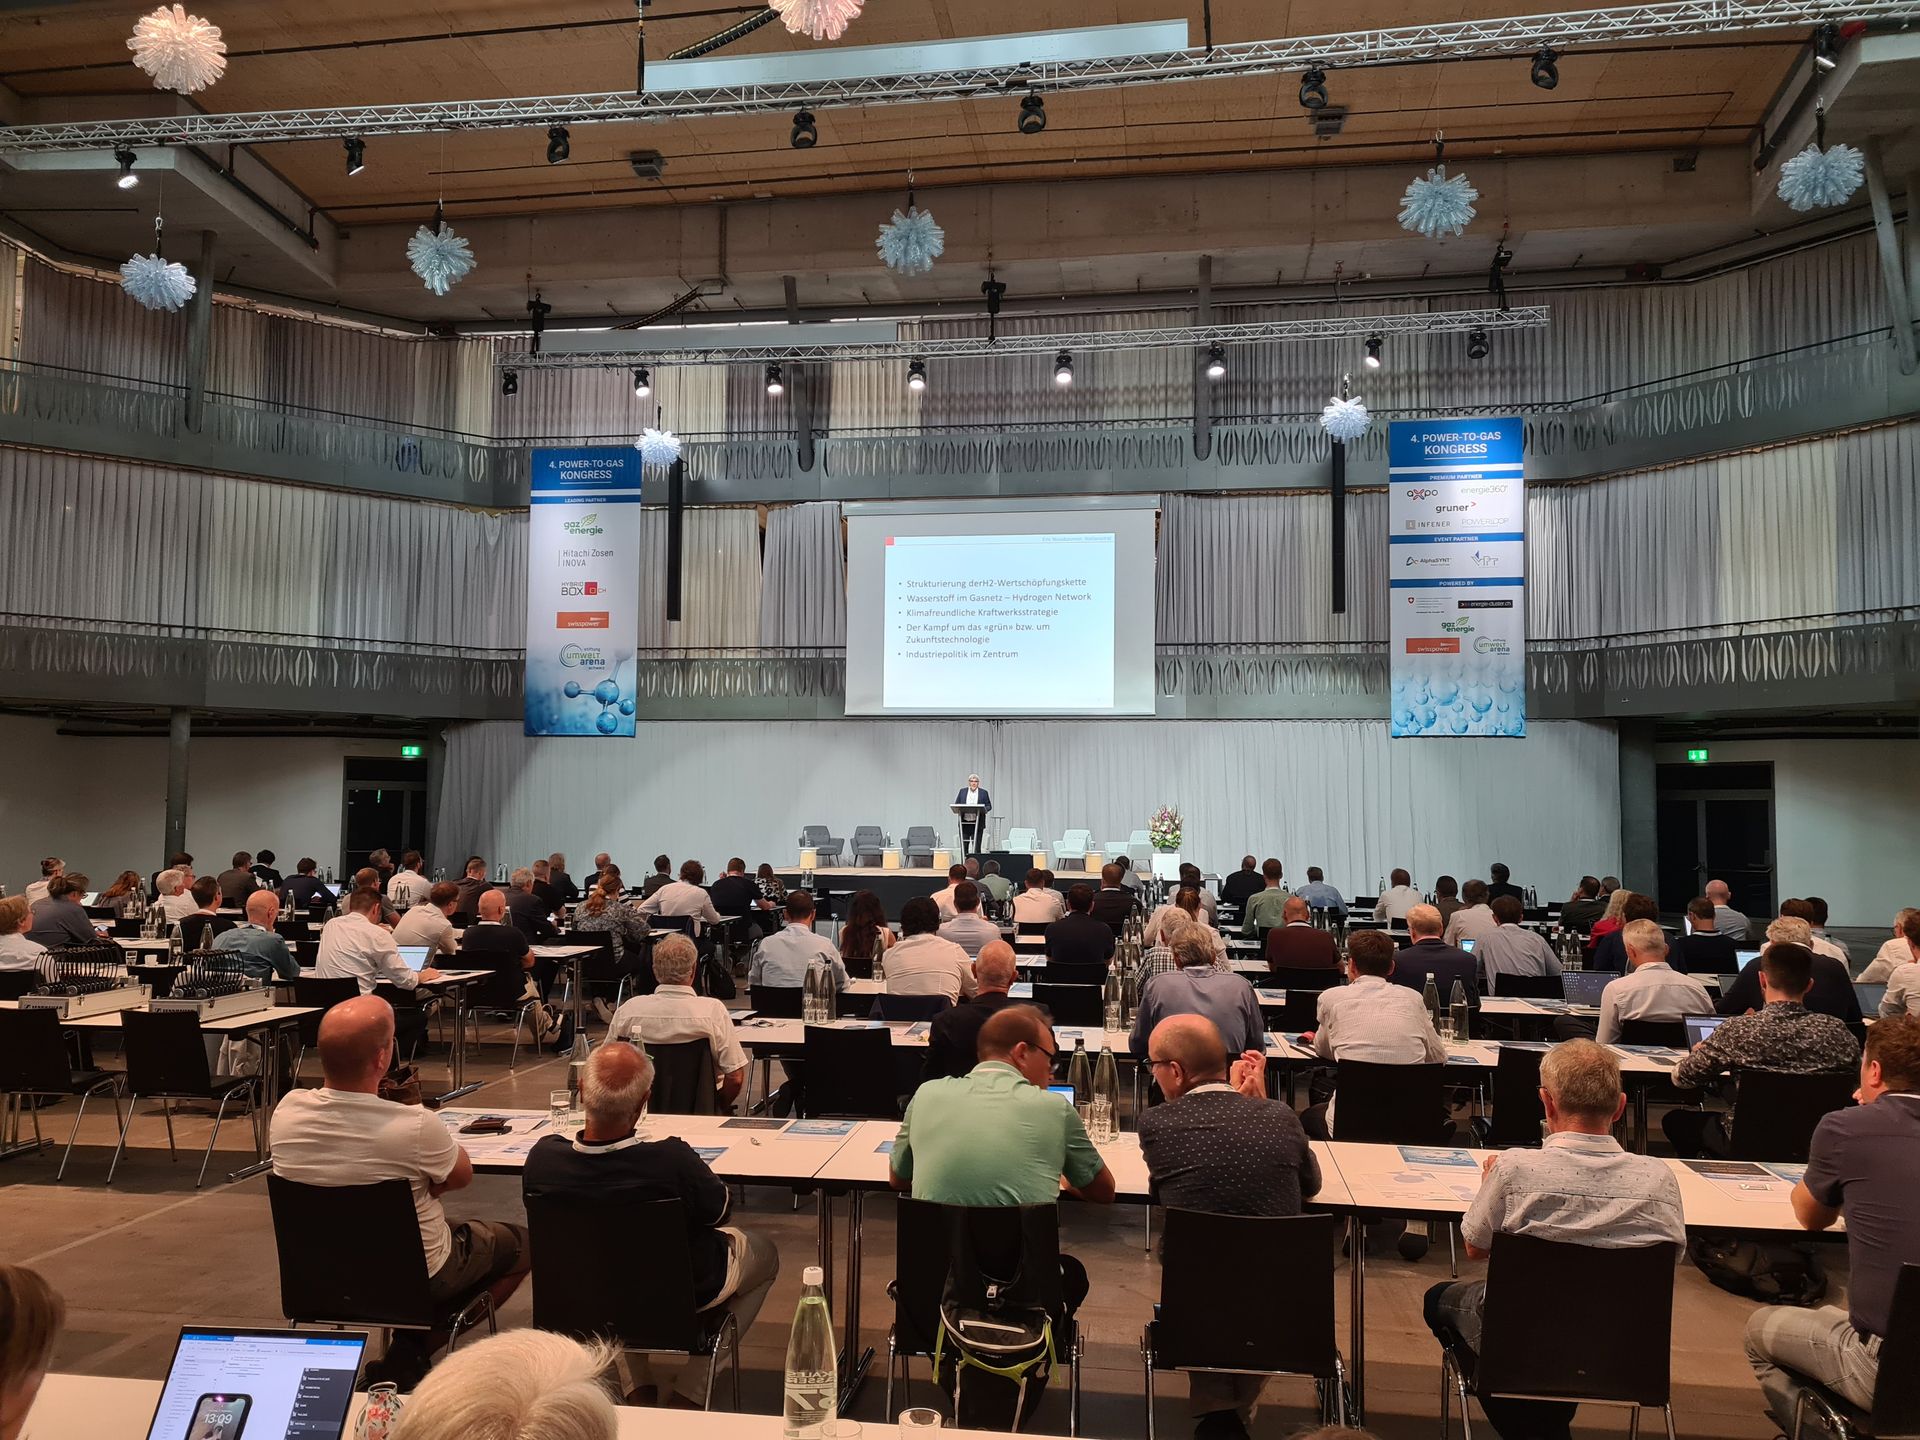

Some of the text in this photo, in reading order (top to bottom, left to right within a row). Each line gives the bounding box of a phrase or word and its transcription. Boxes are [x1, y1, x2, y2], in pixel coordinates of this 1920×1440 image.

[1410, 432, 1501, 442] 4. POWER-TO-GAS
[1424, 444, 1488, 455] KONGRESS
[559, 460, 624, 468] POWER-TO-GAS
[560, 470, 612, 480] KONGRESS
[1436, 504, 1469, 513] gruner
[564, 521, 580, 530] gaz
[570, 526, 604, 535] energie
[563, 549, 614, 557] Hitachi Zosen
[907, 578, 1087, 589] Strukturierung derH2-Wertschöpfungskette
[561, 587, 584, 596] BOX
[1012, 594, 1053, 602] Hydrogen
[978, 608, 1058, 617] Kraftwerksstrategie
[924, 623, 950, 632] Kampf
[906, 636, 990, 645] Zukunftstechnologie
[906, 650, 968, 659] Industriepolitik
[204, 1413, 233, 1424] 13:09
